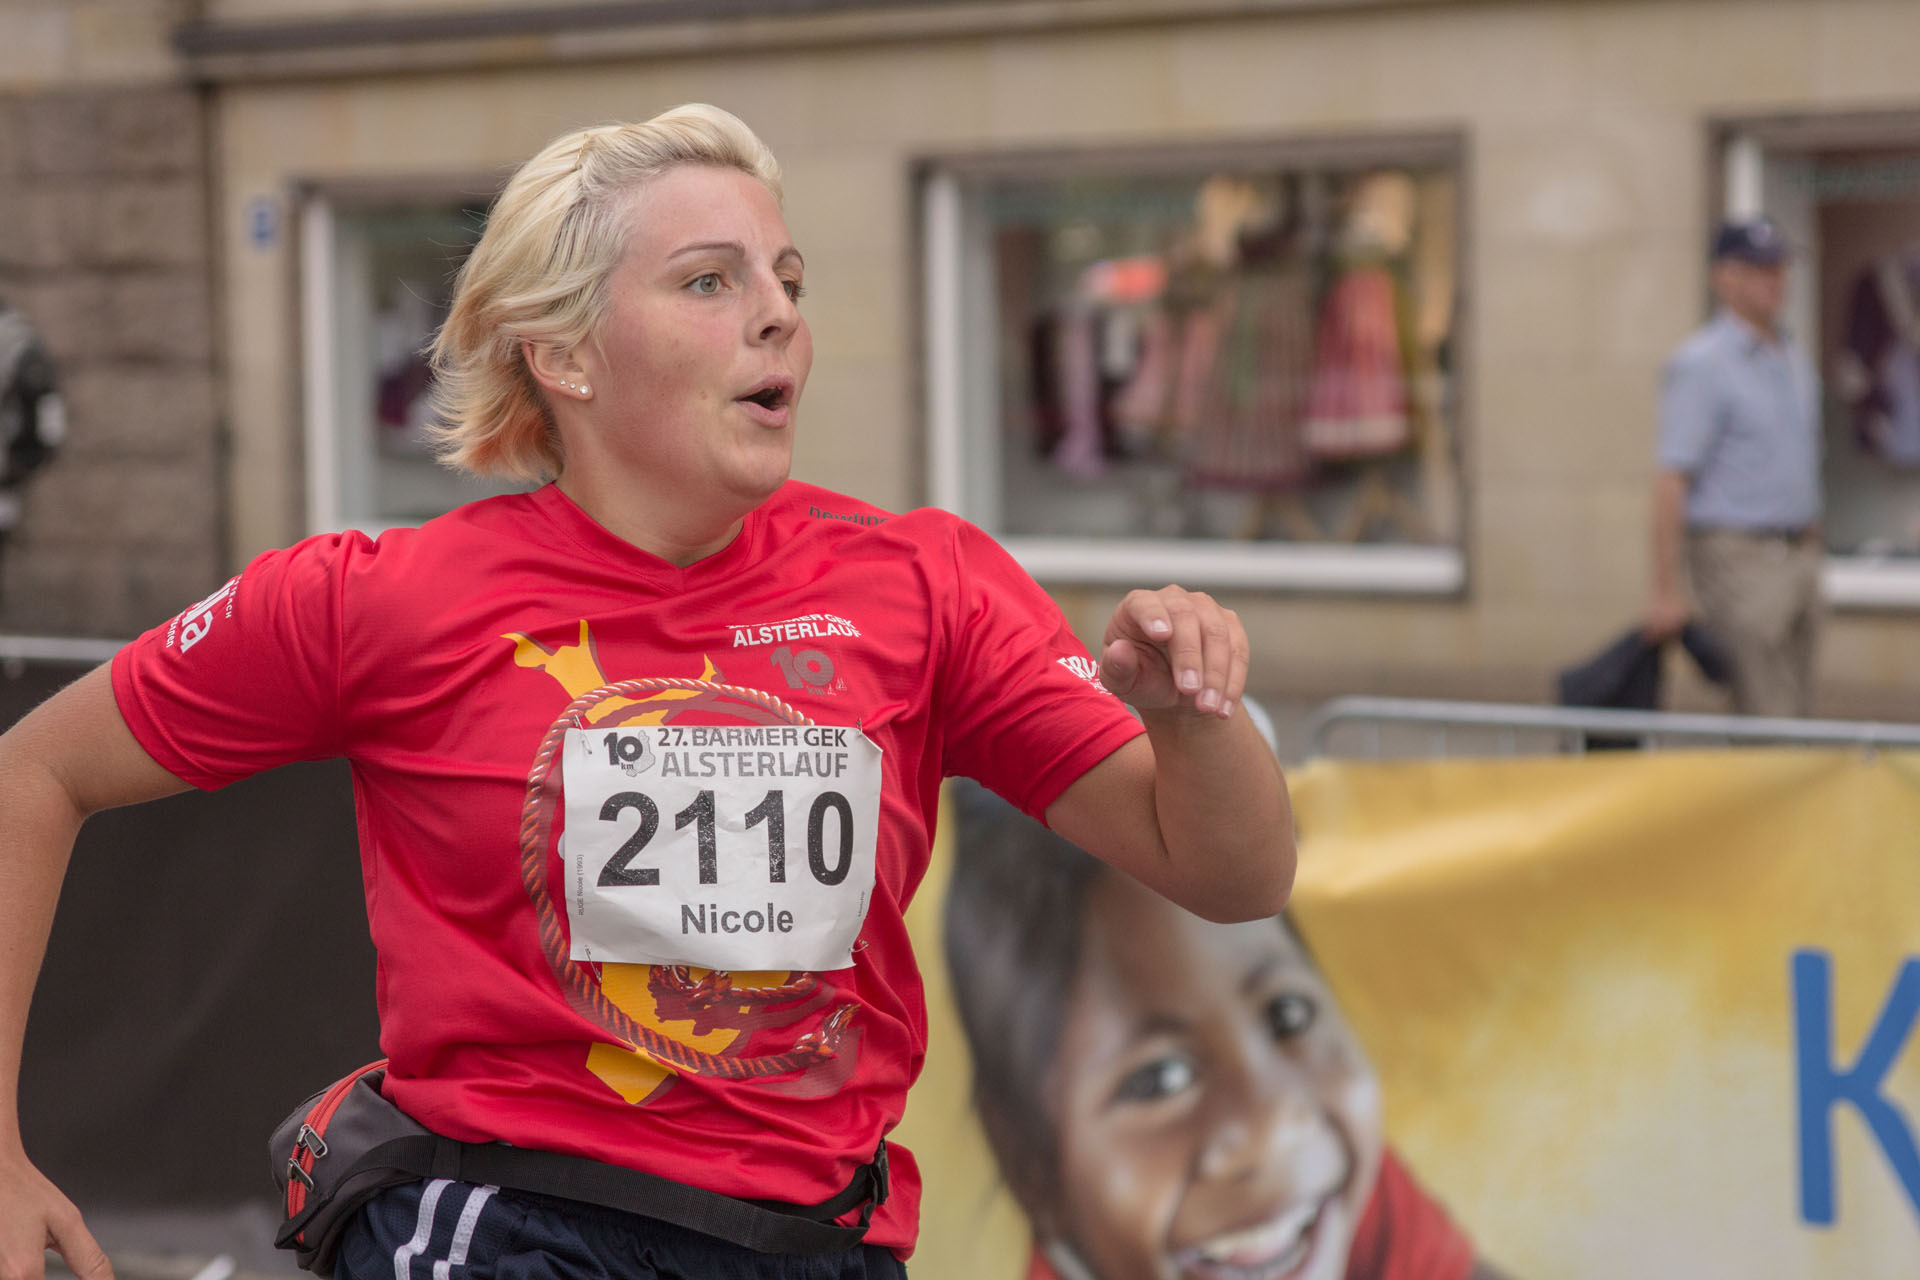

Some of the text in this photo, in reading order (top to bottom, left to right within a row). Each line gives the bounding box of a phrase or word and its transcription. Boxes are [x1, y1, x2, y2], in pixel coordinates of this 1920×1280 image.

[733, 622, 861, 648] ALSTERLAUF
[770, 646, 834, 689] 10
[603, 732, 643, 765] 10
[658, 727, 848, 747] 27. BARMER GEK
[621, 763, 634, 771] km
[661, 751, 849, 778] ALSTERLAUF
[597, 790, 854, 887] 2110
[680, 903, 794, 935] Nicole
